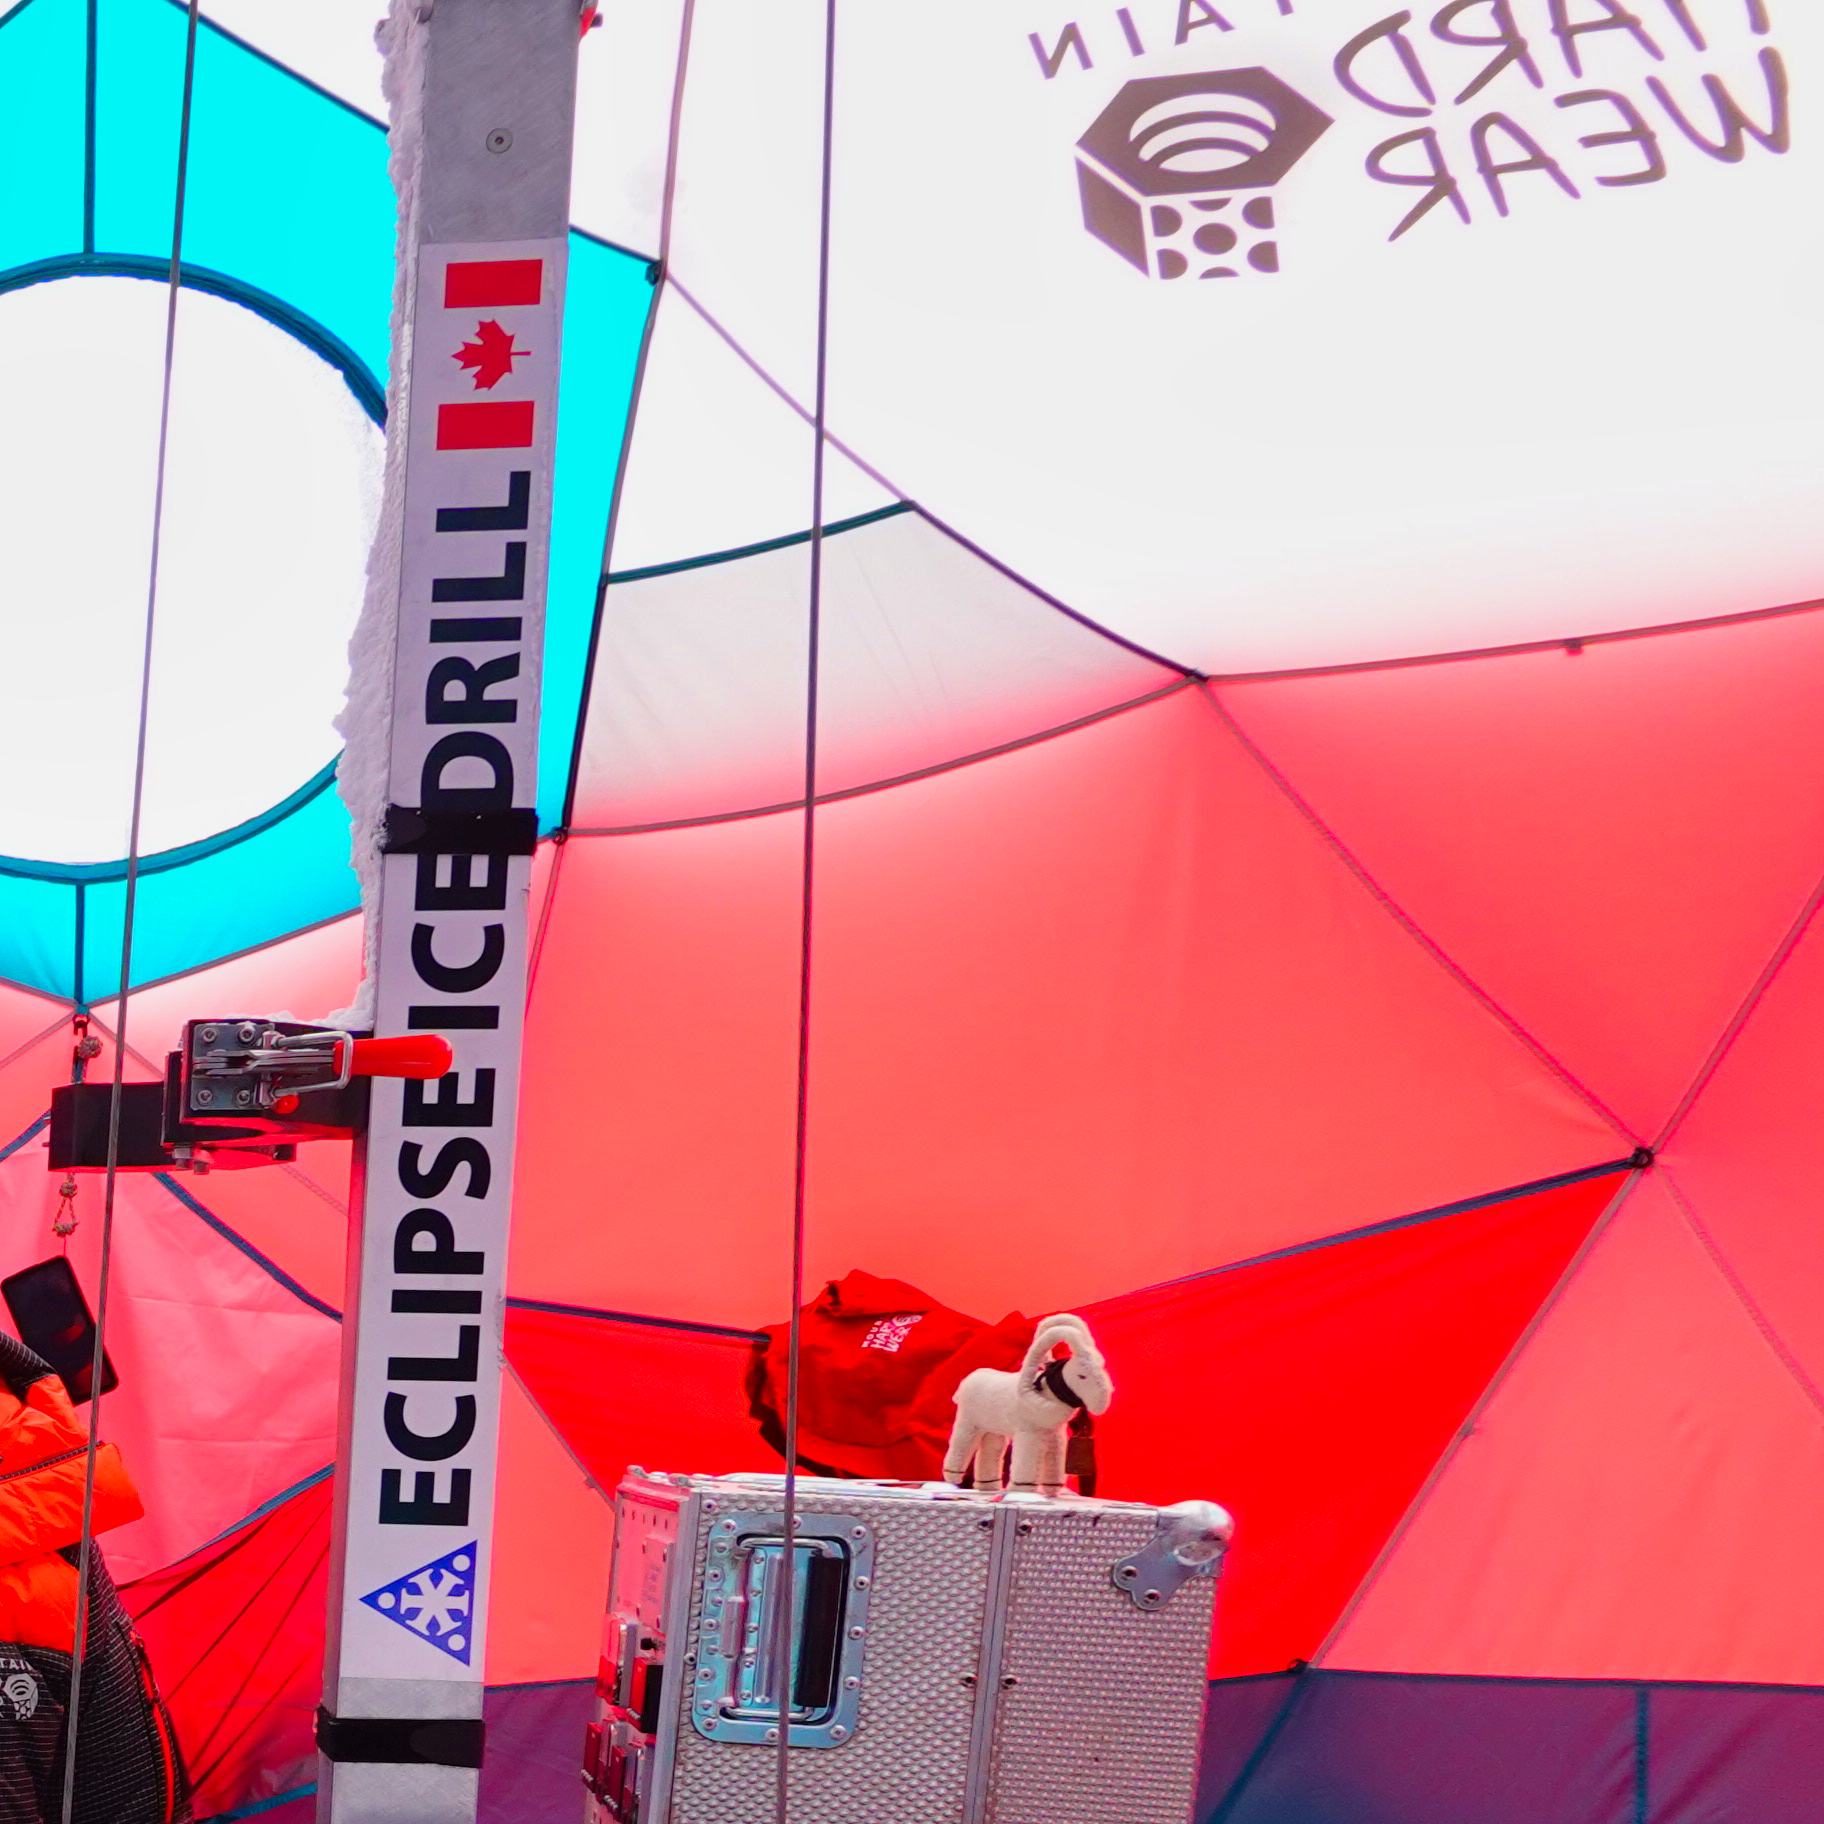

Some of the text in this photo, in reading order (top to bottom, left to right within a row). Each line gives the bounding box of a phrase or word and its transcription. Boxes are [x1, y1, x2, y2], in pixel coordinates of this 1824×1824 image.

[378, 470, 532, 1527] ECLIPSE ICE DRILL
